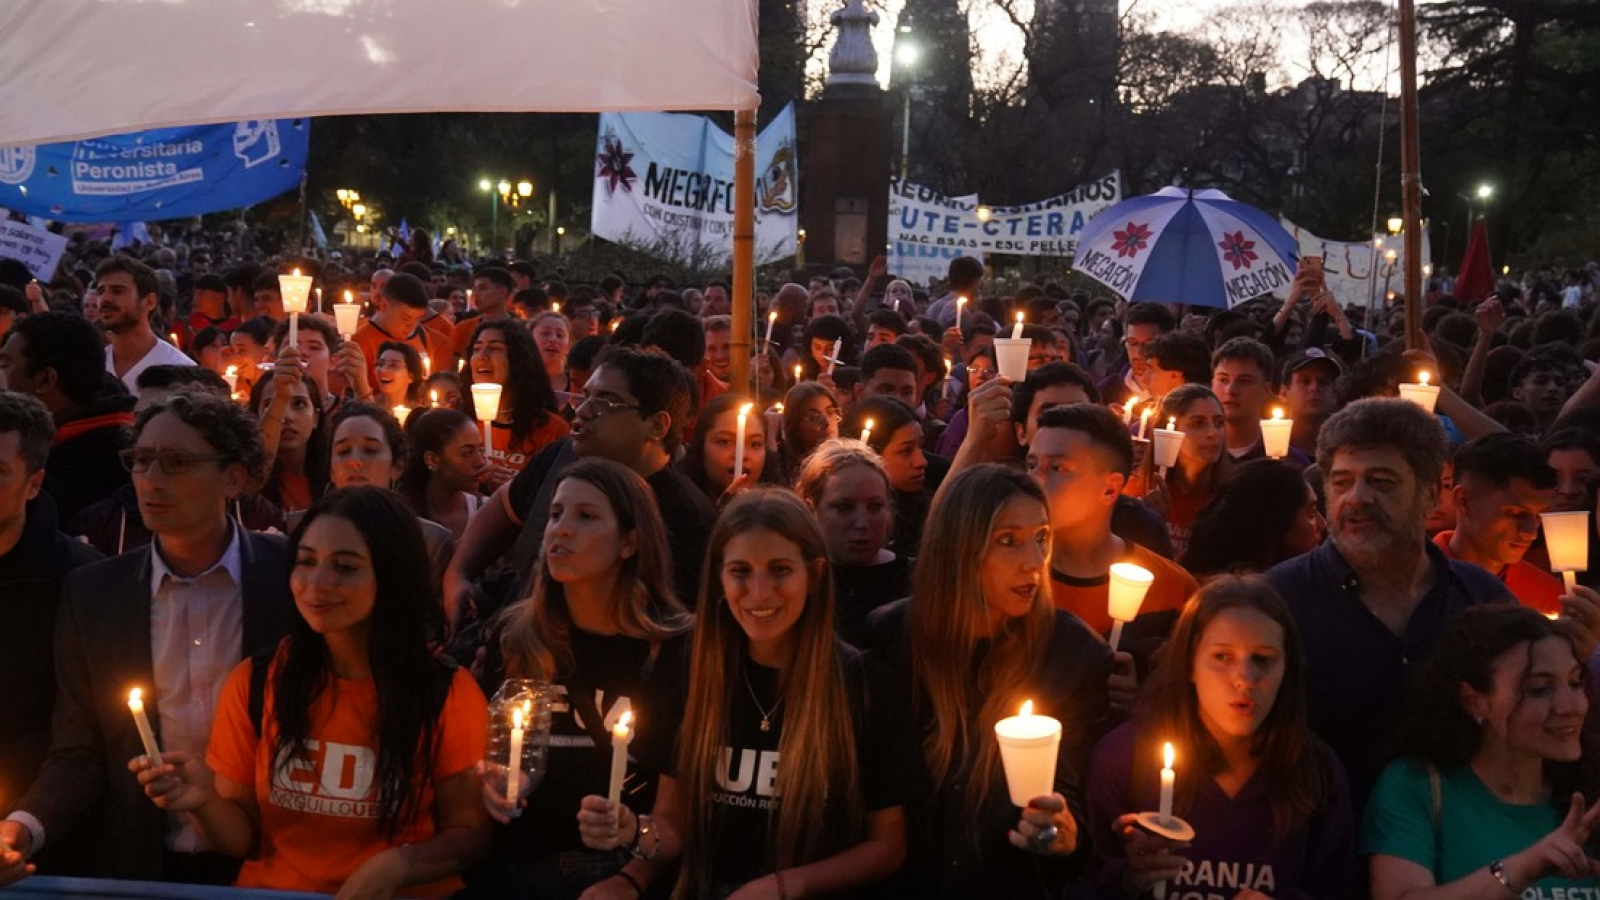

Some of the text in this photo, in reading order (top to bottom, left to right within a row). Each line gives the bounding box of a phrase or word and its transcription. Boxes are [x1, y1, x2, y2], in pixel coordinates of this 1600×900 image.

[76, 161, 177, 179] Peronista
[644, 161, 760, 214] MEGAF
[900, 234, 930, 244] NAC
[937, 237, 978, 248] BSAS
[995, 240, 1025, 251] ESC
[1079, 248, 1138, 293] MEGAFÓN
[1225, 261, 1290, 305] MEGAFÓN
